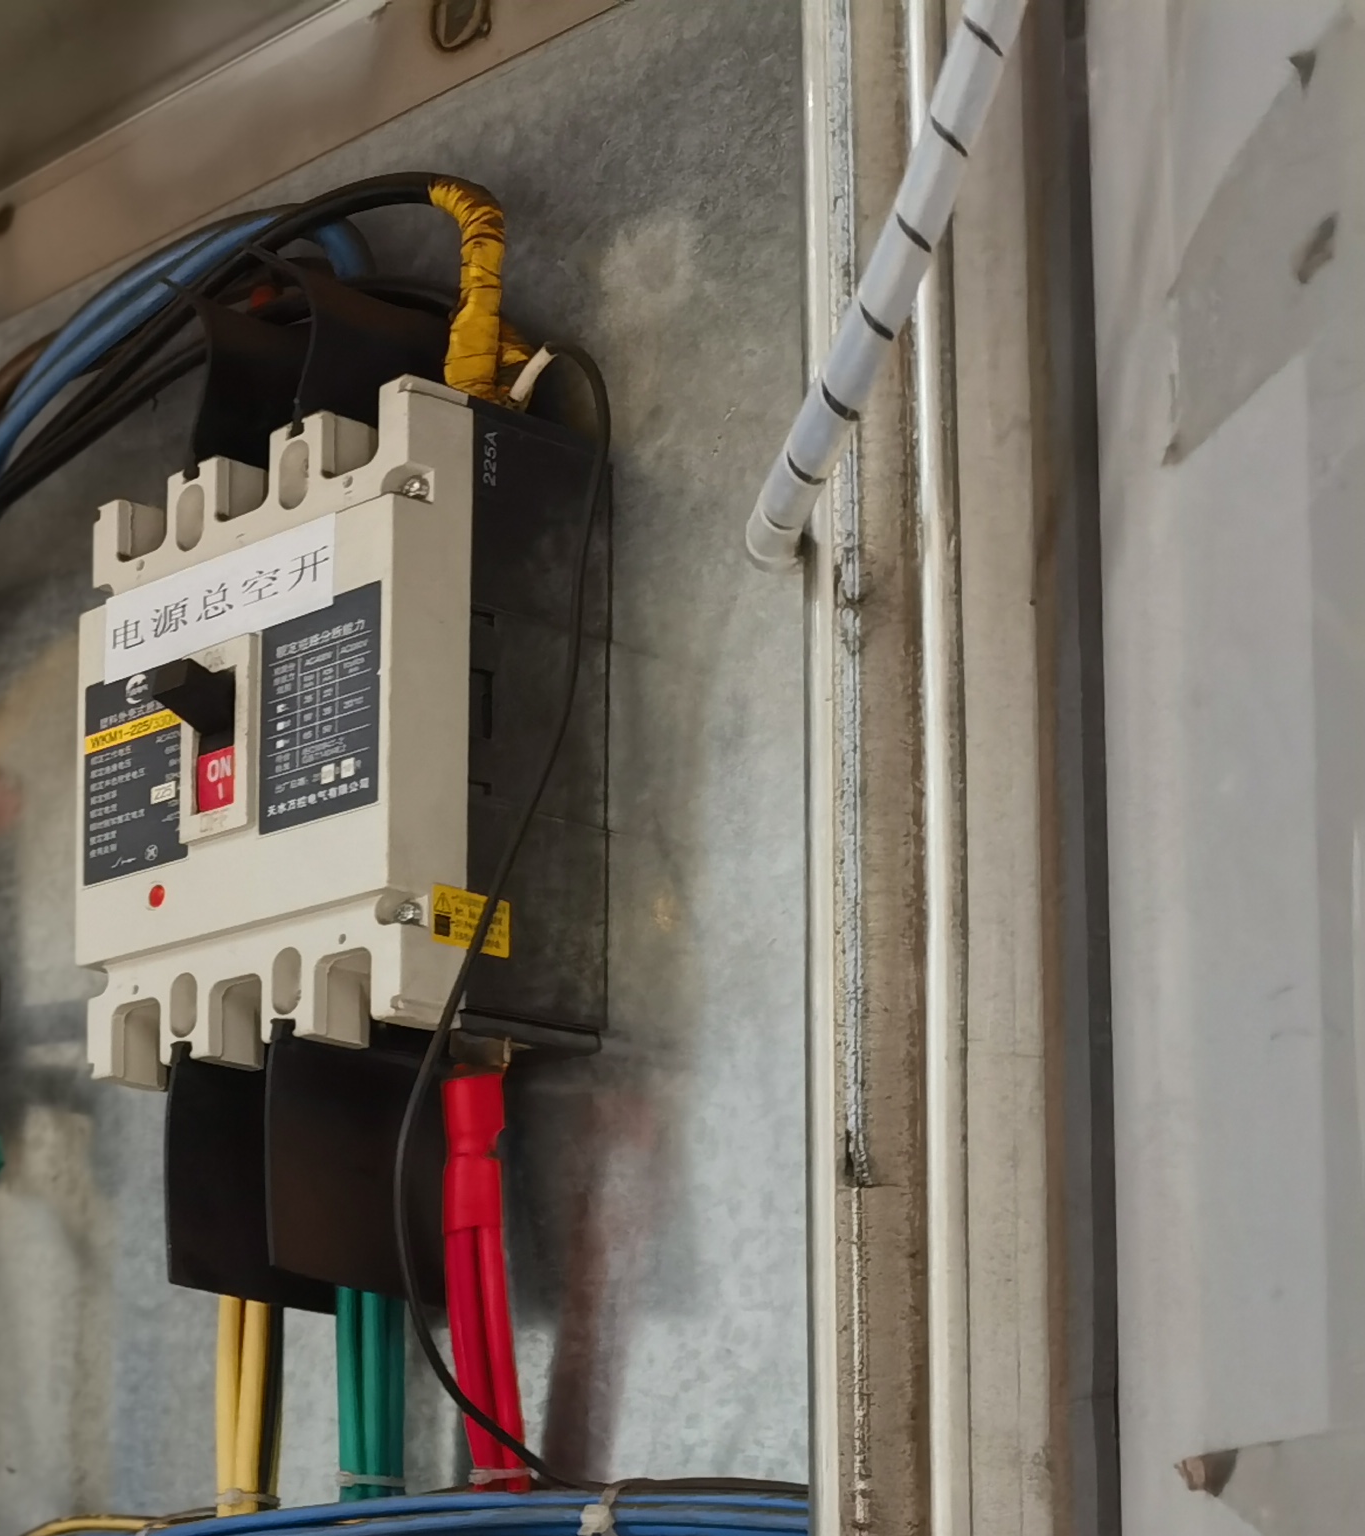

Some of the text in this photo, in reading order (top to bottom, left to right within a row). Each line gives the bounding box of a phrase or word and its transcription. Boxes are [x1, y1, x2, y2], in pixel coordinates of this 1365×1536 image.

[482, 431, 498, 487] 225A
[112, 545, 329, 650] 电源总空开
[207, 755, 232, 782] ON
